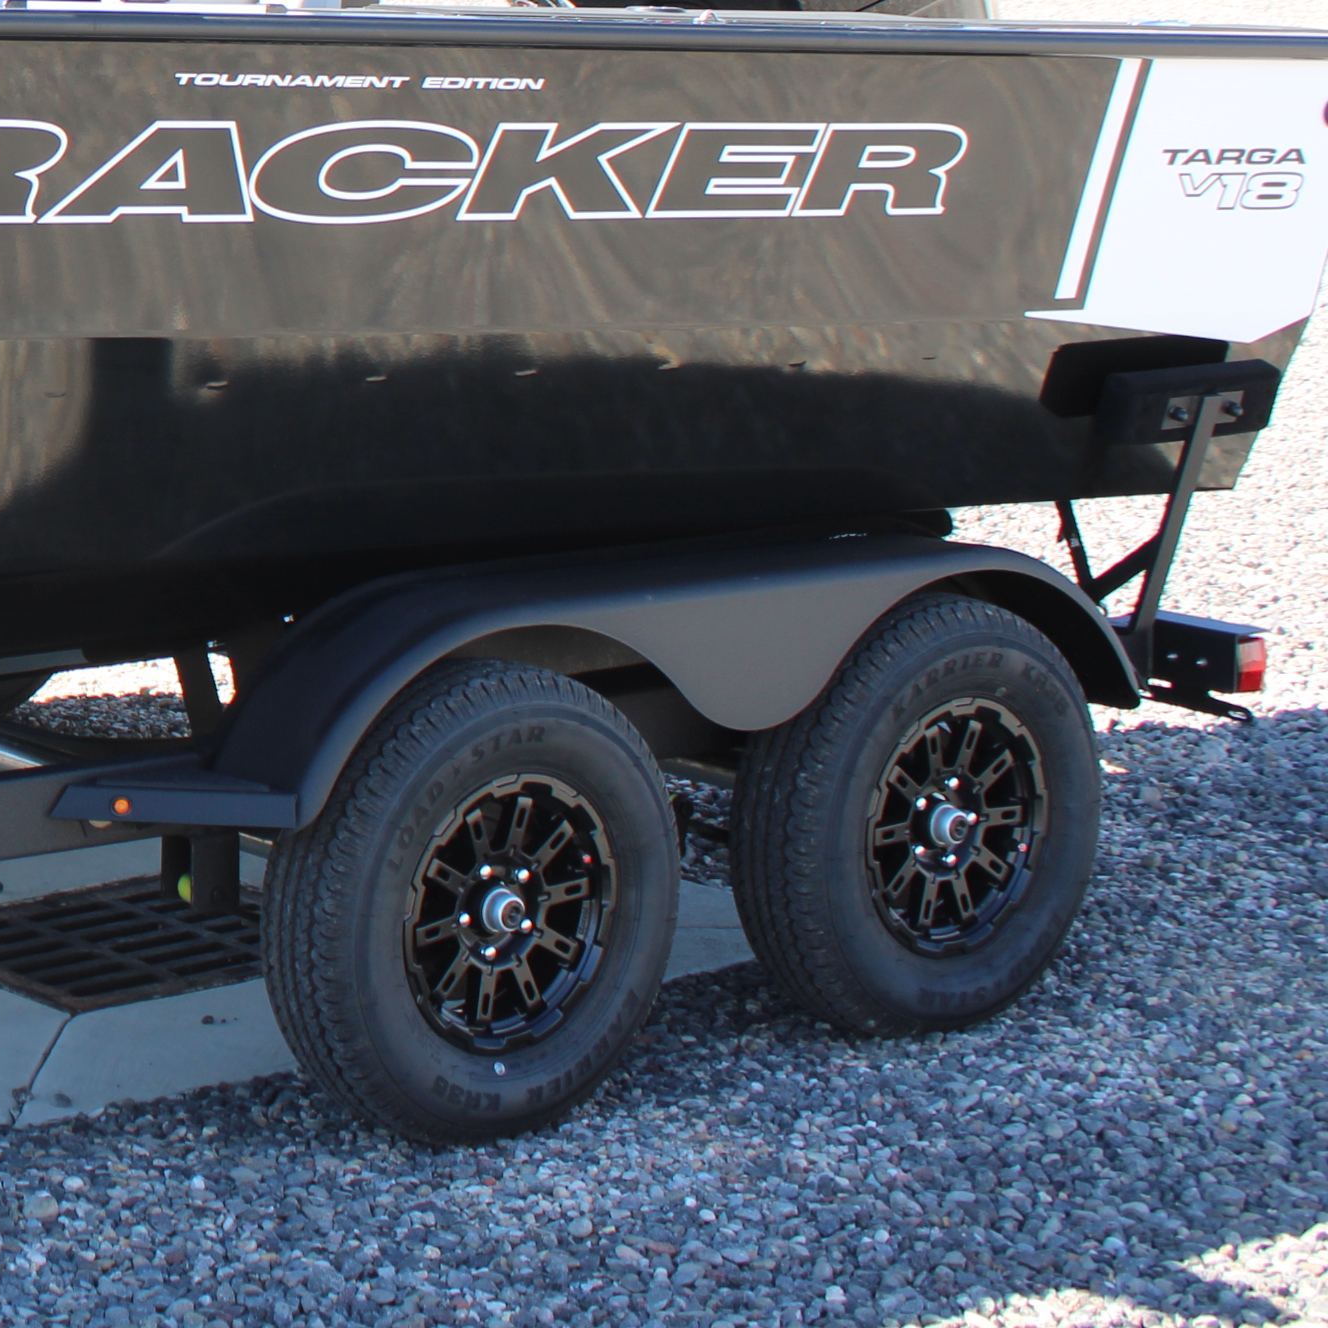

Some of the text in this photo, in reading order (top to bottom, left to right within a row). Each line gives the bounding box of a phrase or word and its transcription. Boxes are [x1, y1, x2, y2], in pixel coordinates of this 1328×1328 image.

[174, 72, 546, 91] TOURNAMENT EDITION
[1161, 148, 1307, 166] TARGA
[1177, 172, 1305, 211] V18
[892, 651, 1005, 721] KARRIER
[386, 725, 547, 876] LOAD STAR
